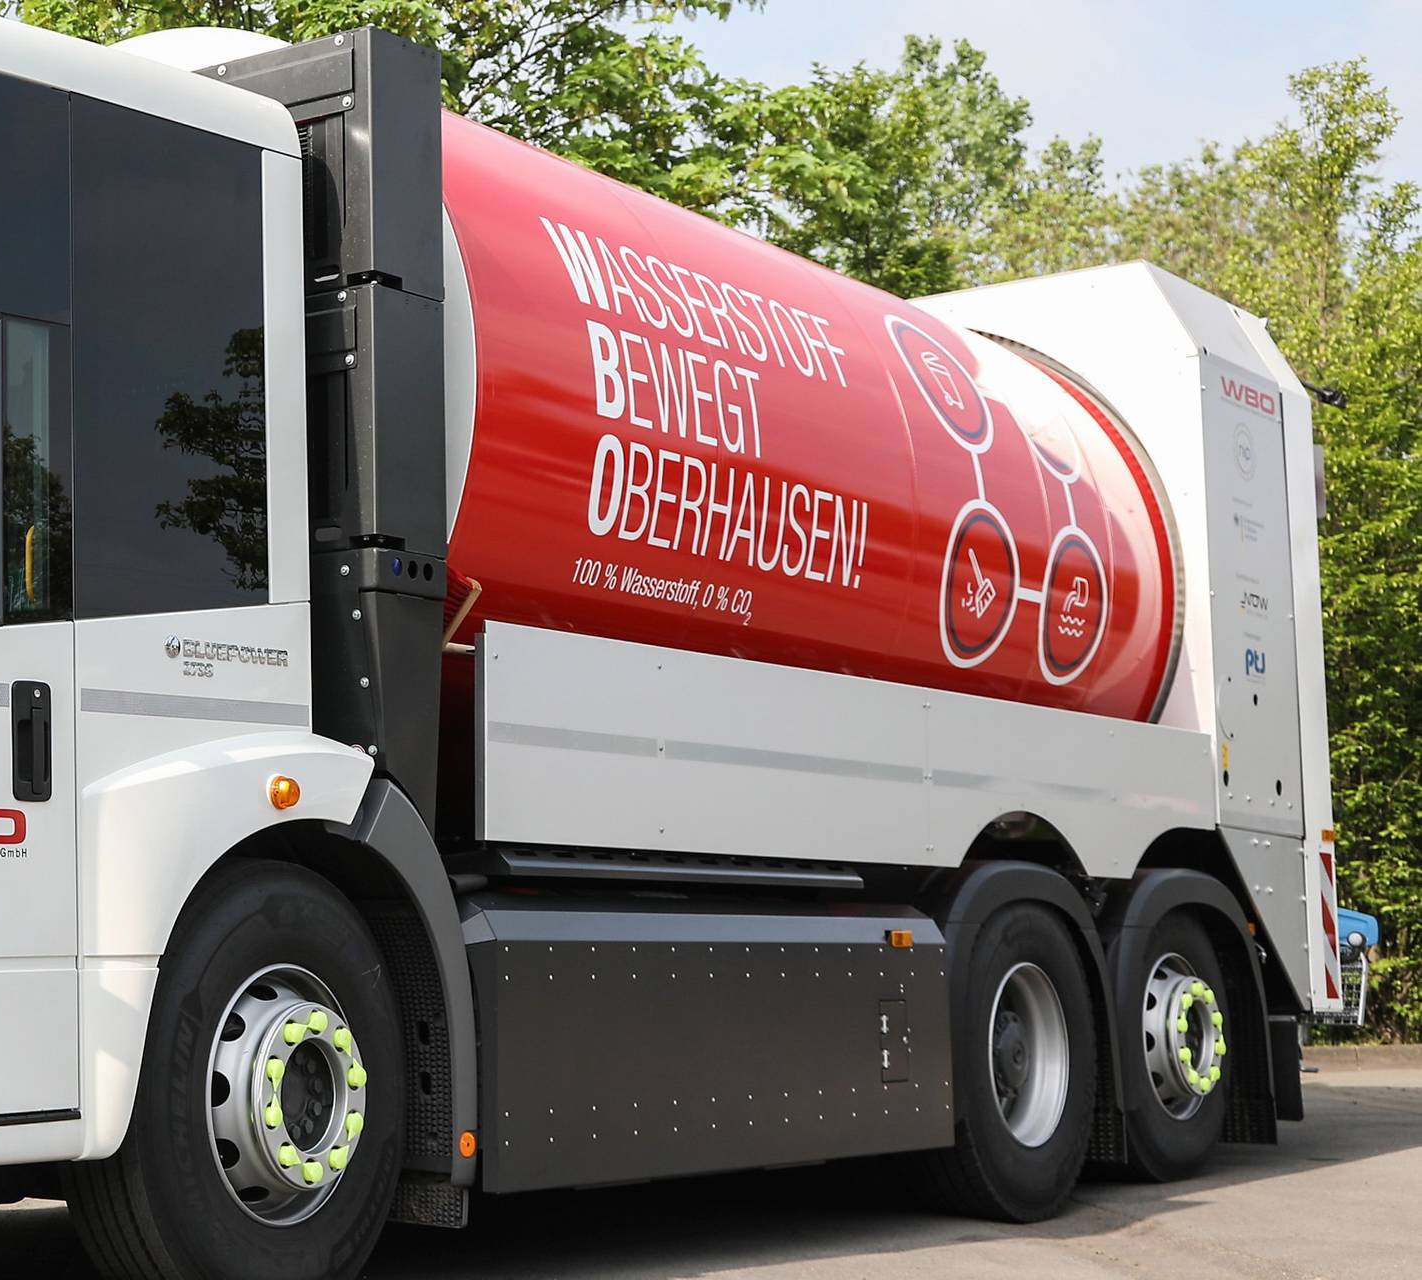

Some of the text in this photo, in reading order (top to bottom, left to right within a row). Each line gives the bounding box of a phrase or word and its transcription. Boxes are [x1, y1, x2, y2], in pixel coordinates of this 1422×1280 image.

[538, 215, 848, 388] WASSERSTOFF
[585, 319, 761, 458] BEWEGT
[1220, 375, 1276, 415] WBO
[587, 434, 868, 589] OBERHAUSEN!
[572, 557, 602, 586] 100
[603, 563, 619, 590] %
[619, 566, 702, 610] Wasserstoff,
[702, 583, 715, 608] 0
[715, 586, 730, 612] %
[182, 639, 289, 667] BLUEPOWER
[0, 848, 28, 859] GmbH
